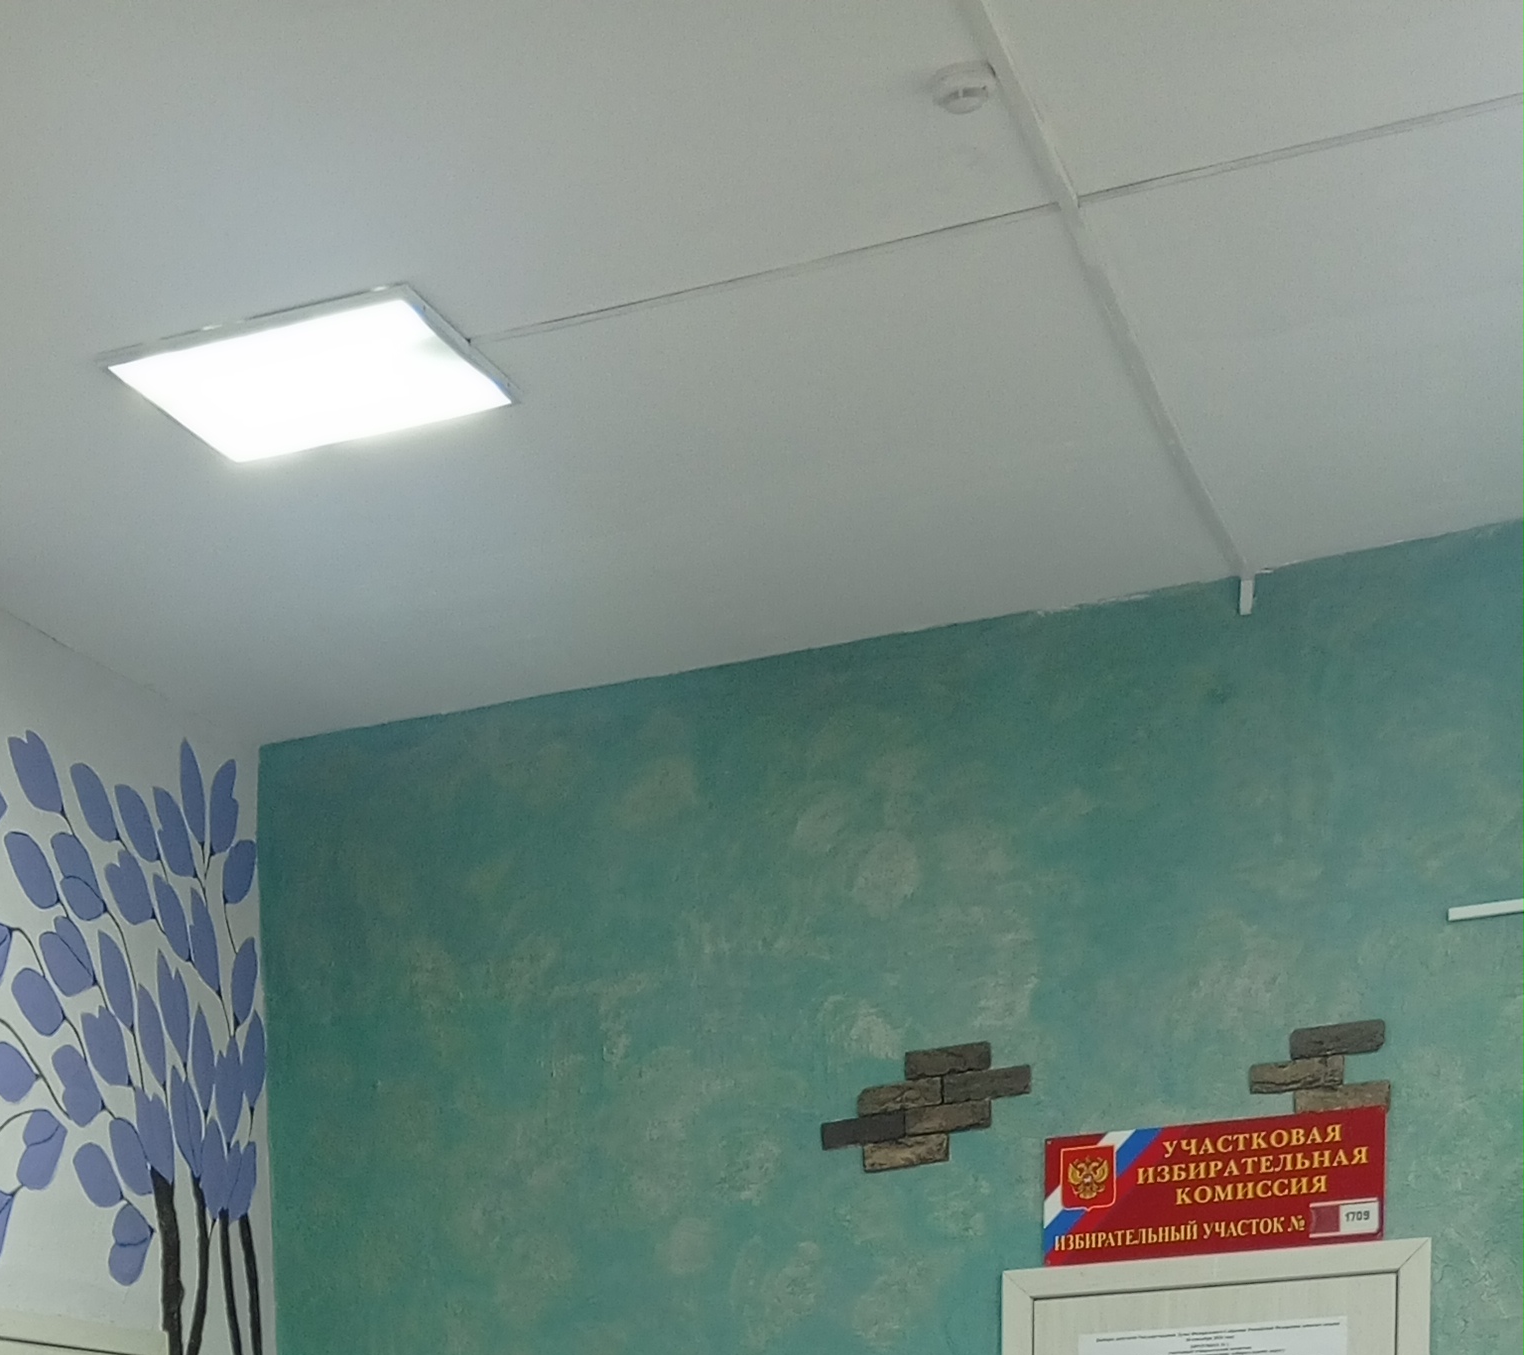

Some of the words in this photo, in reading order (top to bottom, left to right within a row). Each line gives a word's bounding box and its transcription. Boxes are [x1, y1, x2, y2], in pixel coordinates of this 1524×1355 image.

[1162, 1123, 1343, 1159] УЧАСТКОВАЯ
[1136, 1146, 1369, 1186] ИЗБИРАТЕЛЬНАЯ
[1175, 1175, 1328, 1206] КОМИССИЯ
[1053, 1220, 1199, 1252] ИЗБИРАТЕЛЬНЫЙ
[1202, 1215, 1286, 1240] УЧАСТОК
[1344, 1210, 1371, 1223] 1709
